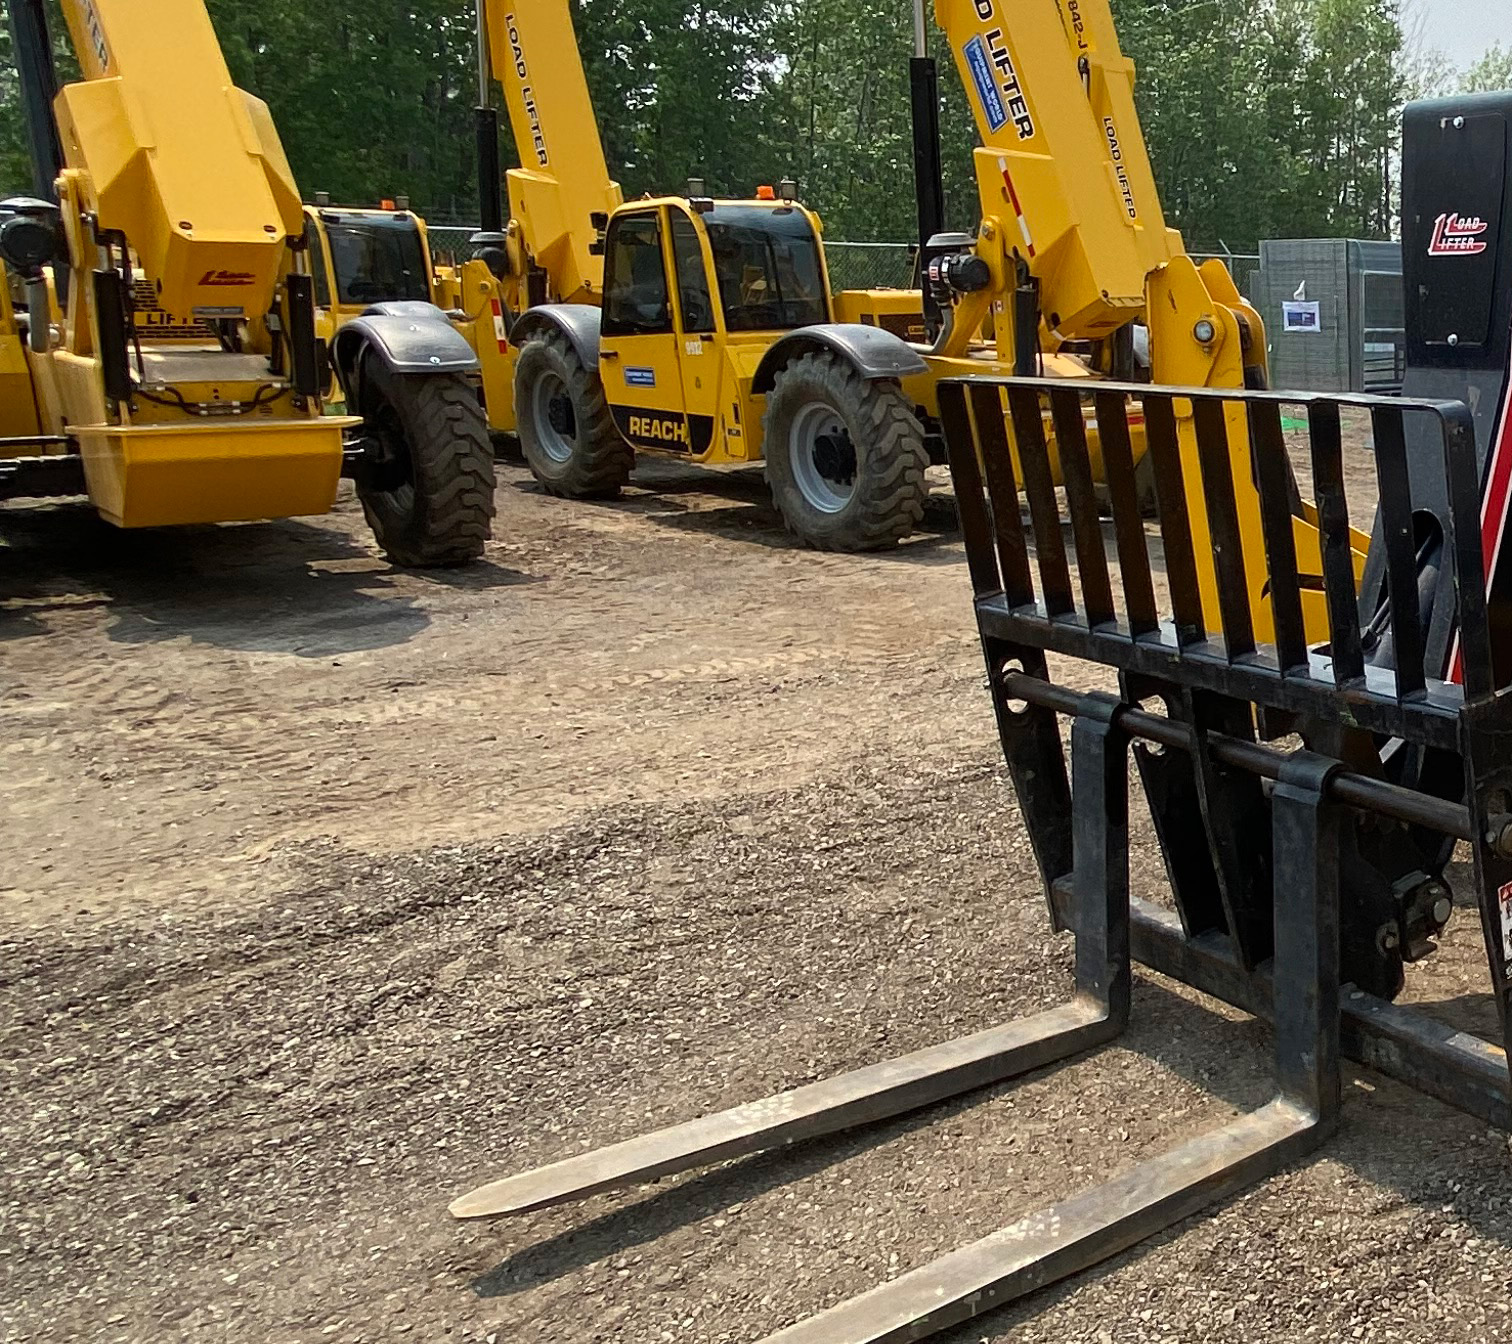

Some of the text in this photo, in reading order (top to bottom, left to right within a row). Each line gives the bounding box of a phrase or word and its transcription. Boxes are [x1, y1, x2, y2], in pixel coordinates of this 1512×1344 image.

[1067, 0, 1089, 50] 842-J
[504, 13, 549, 167] LOAD LIFTER
[984, 26, 1035, 141] LIFTER
[1103, 116, 1122, 161] LOAD
[1427, 213, 1487, 256] LIFTER
[1444, 212, 1488, 236] LOAD
[629, 416, 688, 443] REACH
